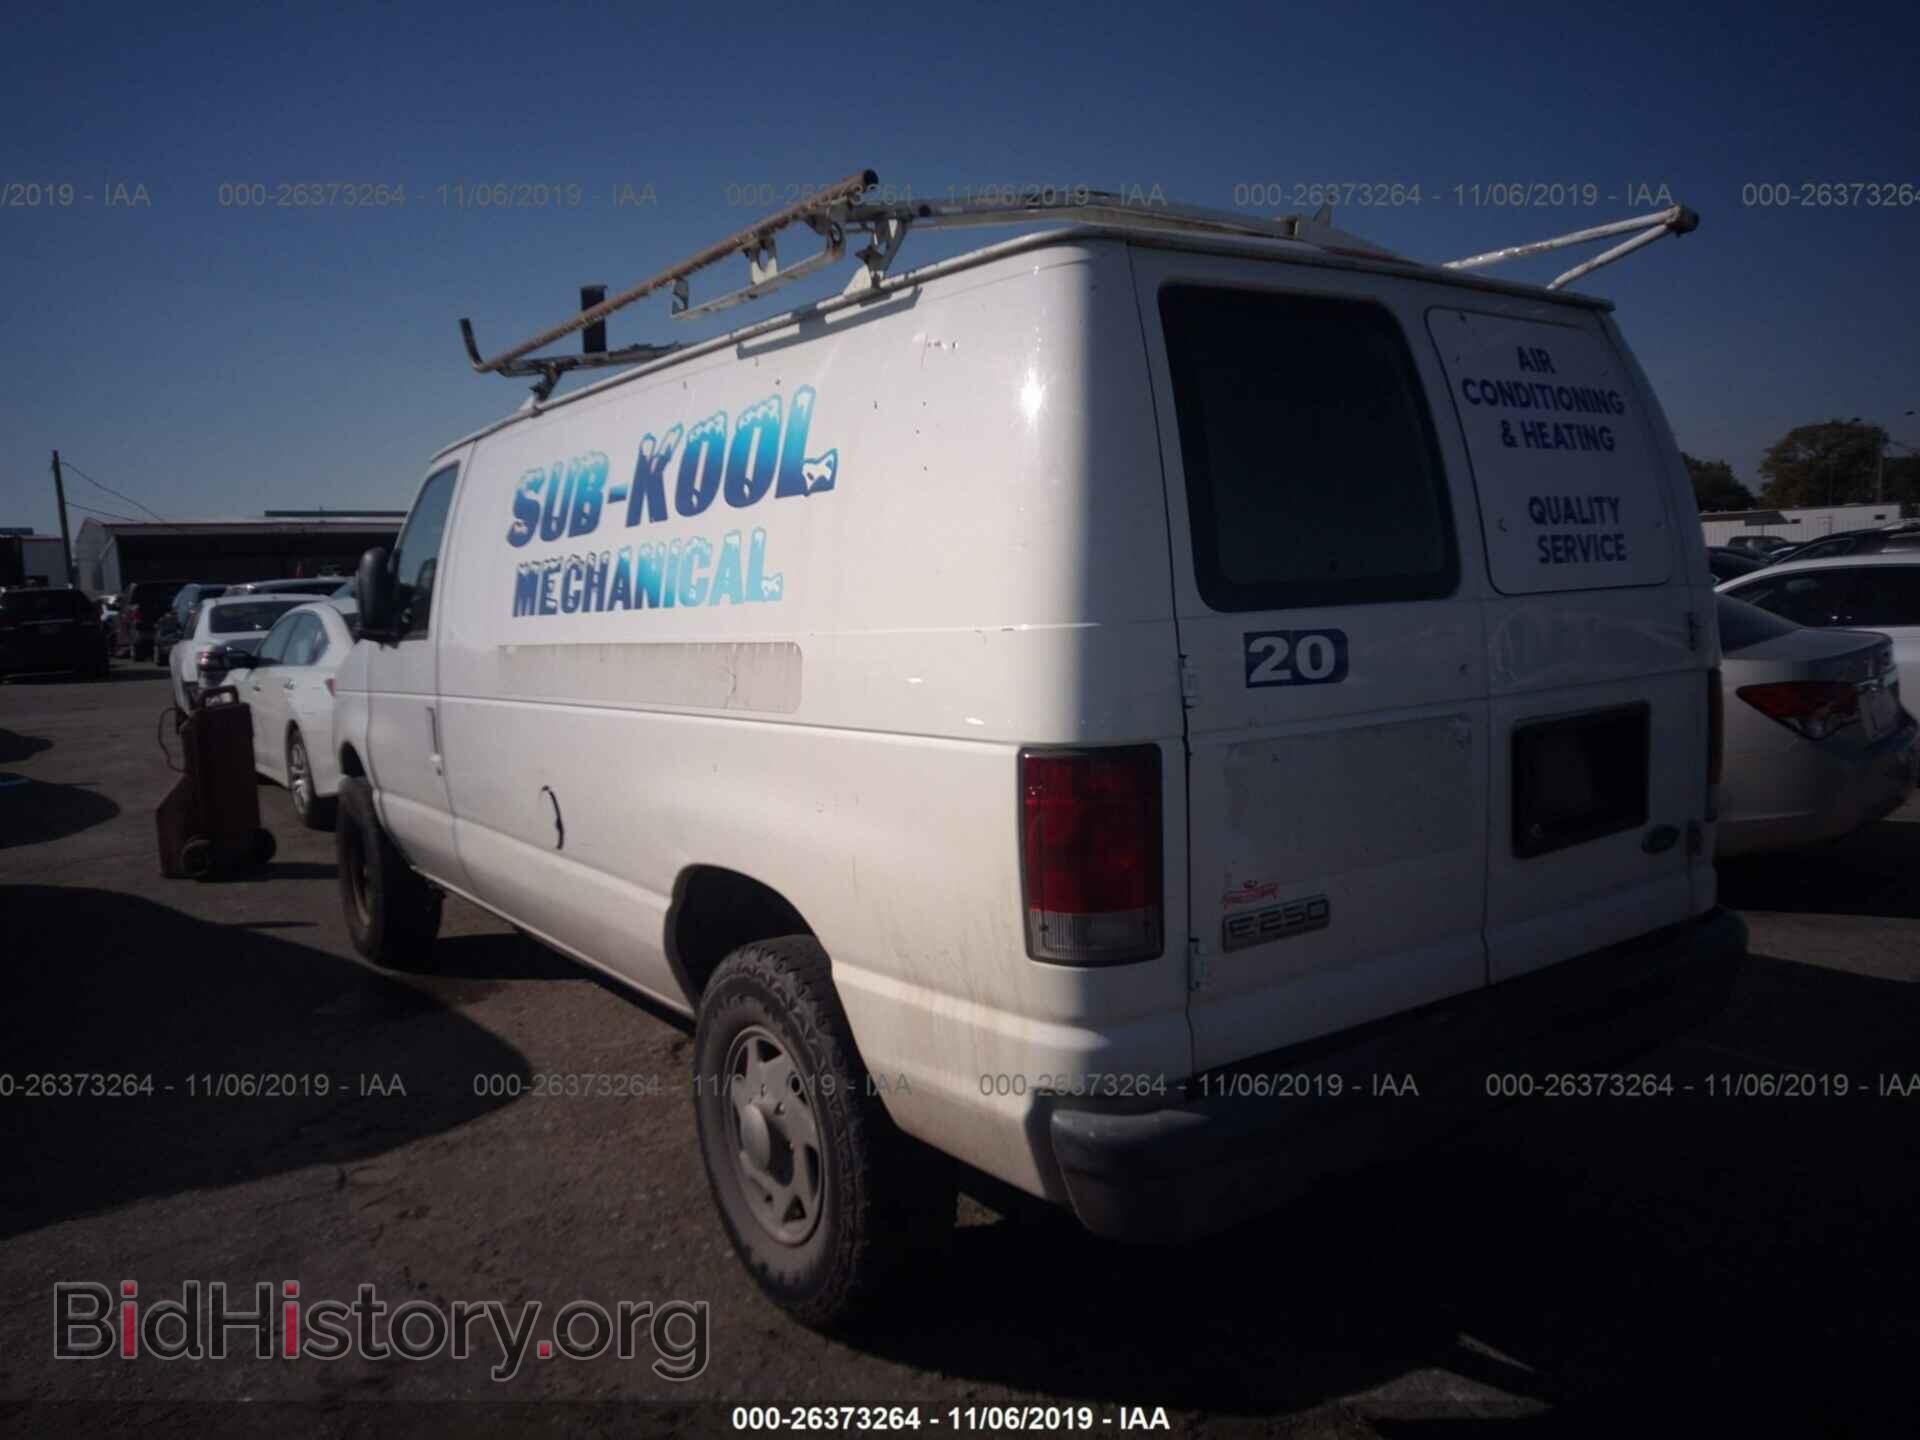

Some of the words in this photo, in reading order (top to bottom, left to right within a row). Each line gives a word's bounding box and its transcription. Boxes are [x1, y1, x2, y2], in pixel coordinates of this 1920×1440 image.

[1517, 346, 1556, 374] AIR
[1462, 378, 1625, 415] CONDITIONING
[1501, 420, 1518, 448] &
[1520, 420, 1615, 451] HEATING
[506, 384, 838, 548] SUB-KOOL
[1528, 496, 1620, 525] QUALITY
[1537, 534, 1627, 564] SERVICE
[512, 526, 783, 618] MECHANICAL
[1248, 634, 1336, 683] 20
